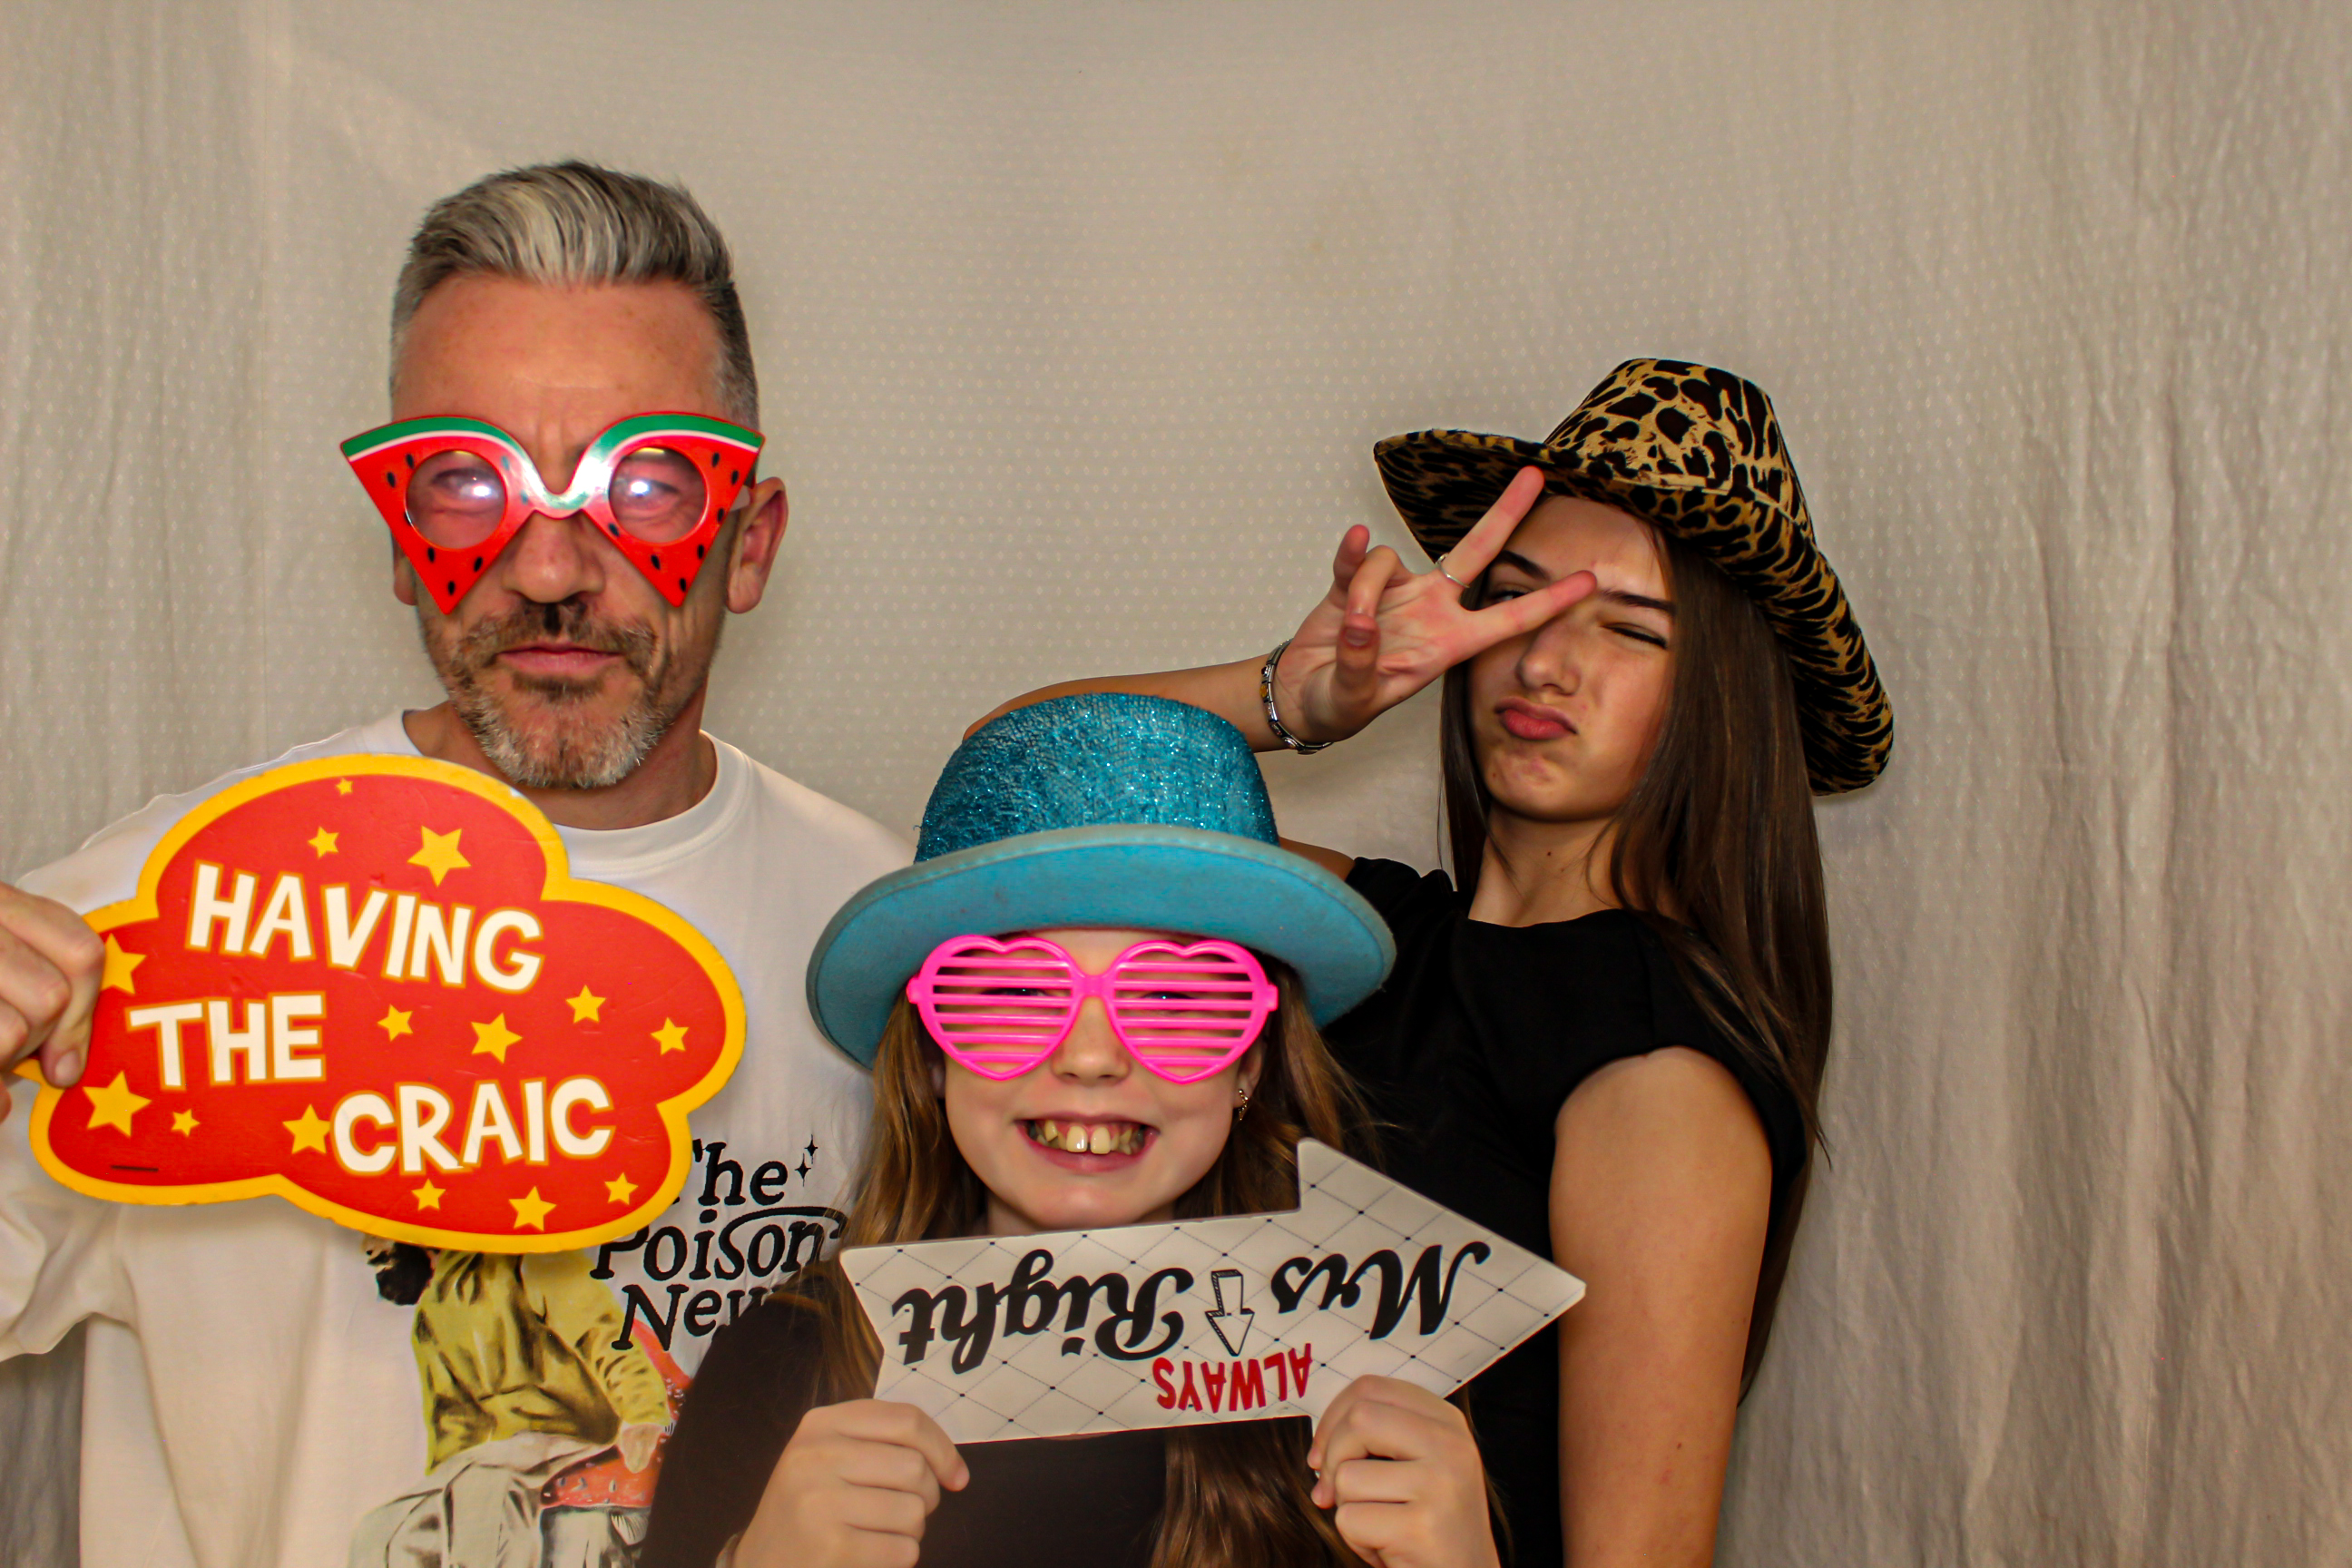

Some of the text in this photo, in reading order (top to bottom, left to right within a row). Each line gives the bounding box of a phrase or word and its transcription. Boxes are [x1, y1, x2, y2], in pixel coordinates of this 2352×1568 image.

[186, 861, 544, 991] HAVING
[129, 994, 325, 1087] THE
[334, 1078, 614, 1173] CRAIC
[675, 1139, 788, 1205] he
[891, 1240, 1491, 1374] Mrs Right
[1152, 1343, 1314, 1413] ALWAYS
